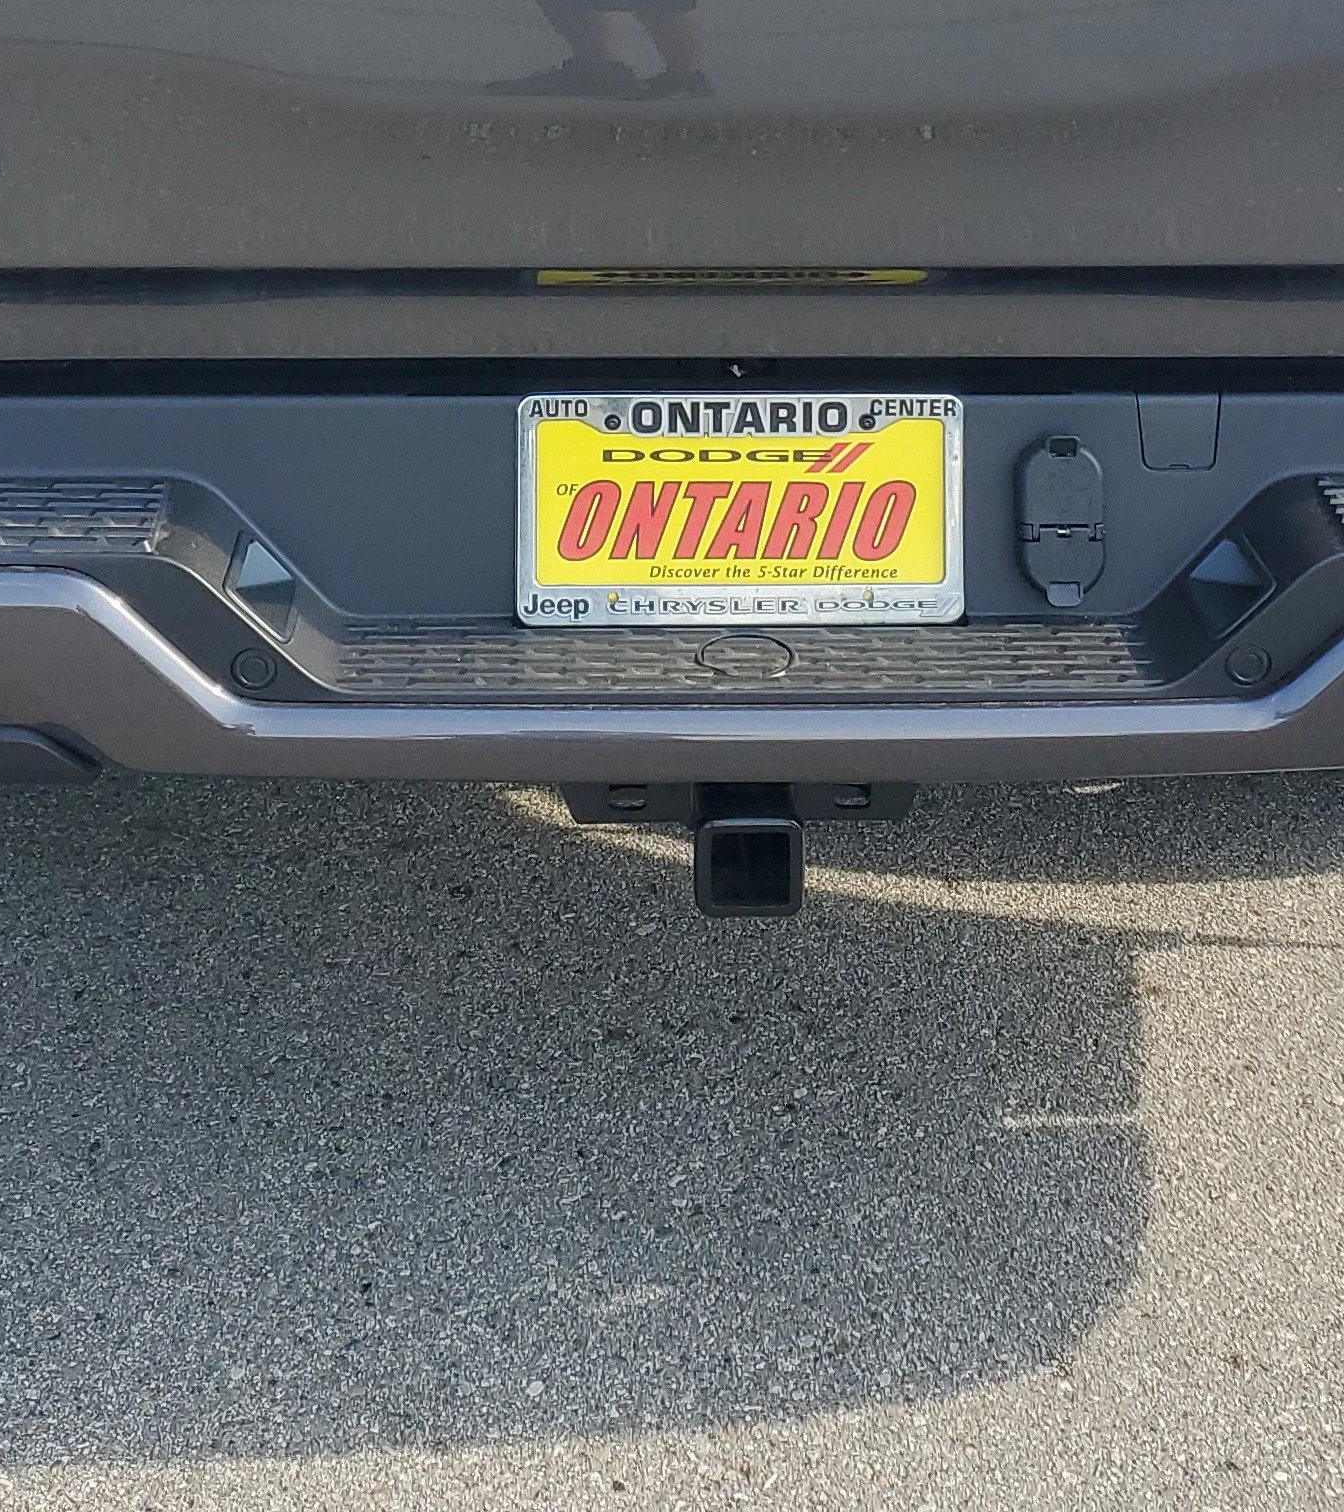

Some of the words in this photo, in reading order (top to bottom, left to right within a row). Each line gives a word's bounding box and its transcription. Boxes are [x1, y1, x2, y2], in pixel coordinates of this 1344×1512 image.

[529, 399, 588, 417] AUTO
[632, 401, 848, 434] ONTARIO
[869, 398, 957, 417] CENTER
[602, 449, 833, 463] DODGE
[556, 483, 579, 496] OF
[557, 480, 917, 562] ONTARIO
[649, 564, 721, 578] Discover
[725, 565, 751, 579] the
[757, 565, 808, 579] 5-Star
[813, 565, 899, 582] Difference
[523, 593, 590, 620] Jeep
[609, 598, 800, 613] CHRYSLER
[817, 599, 940, 611] DODGE
